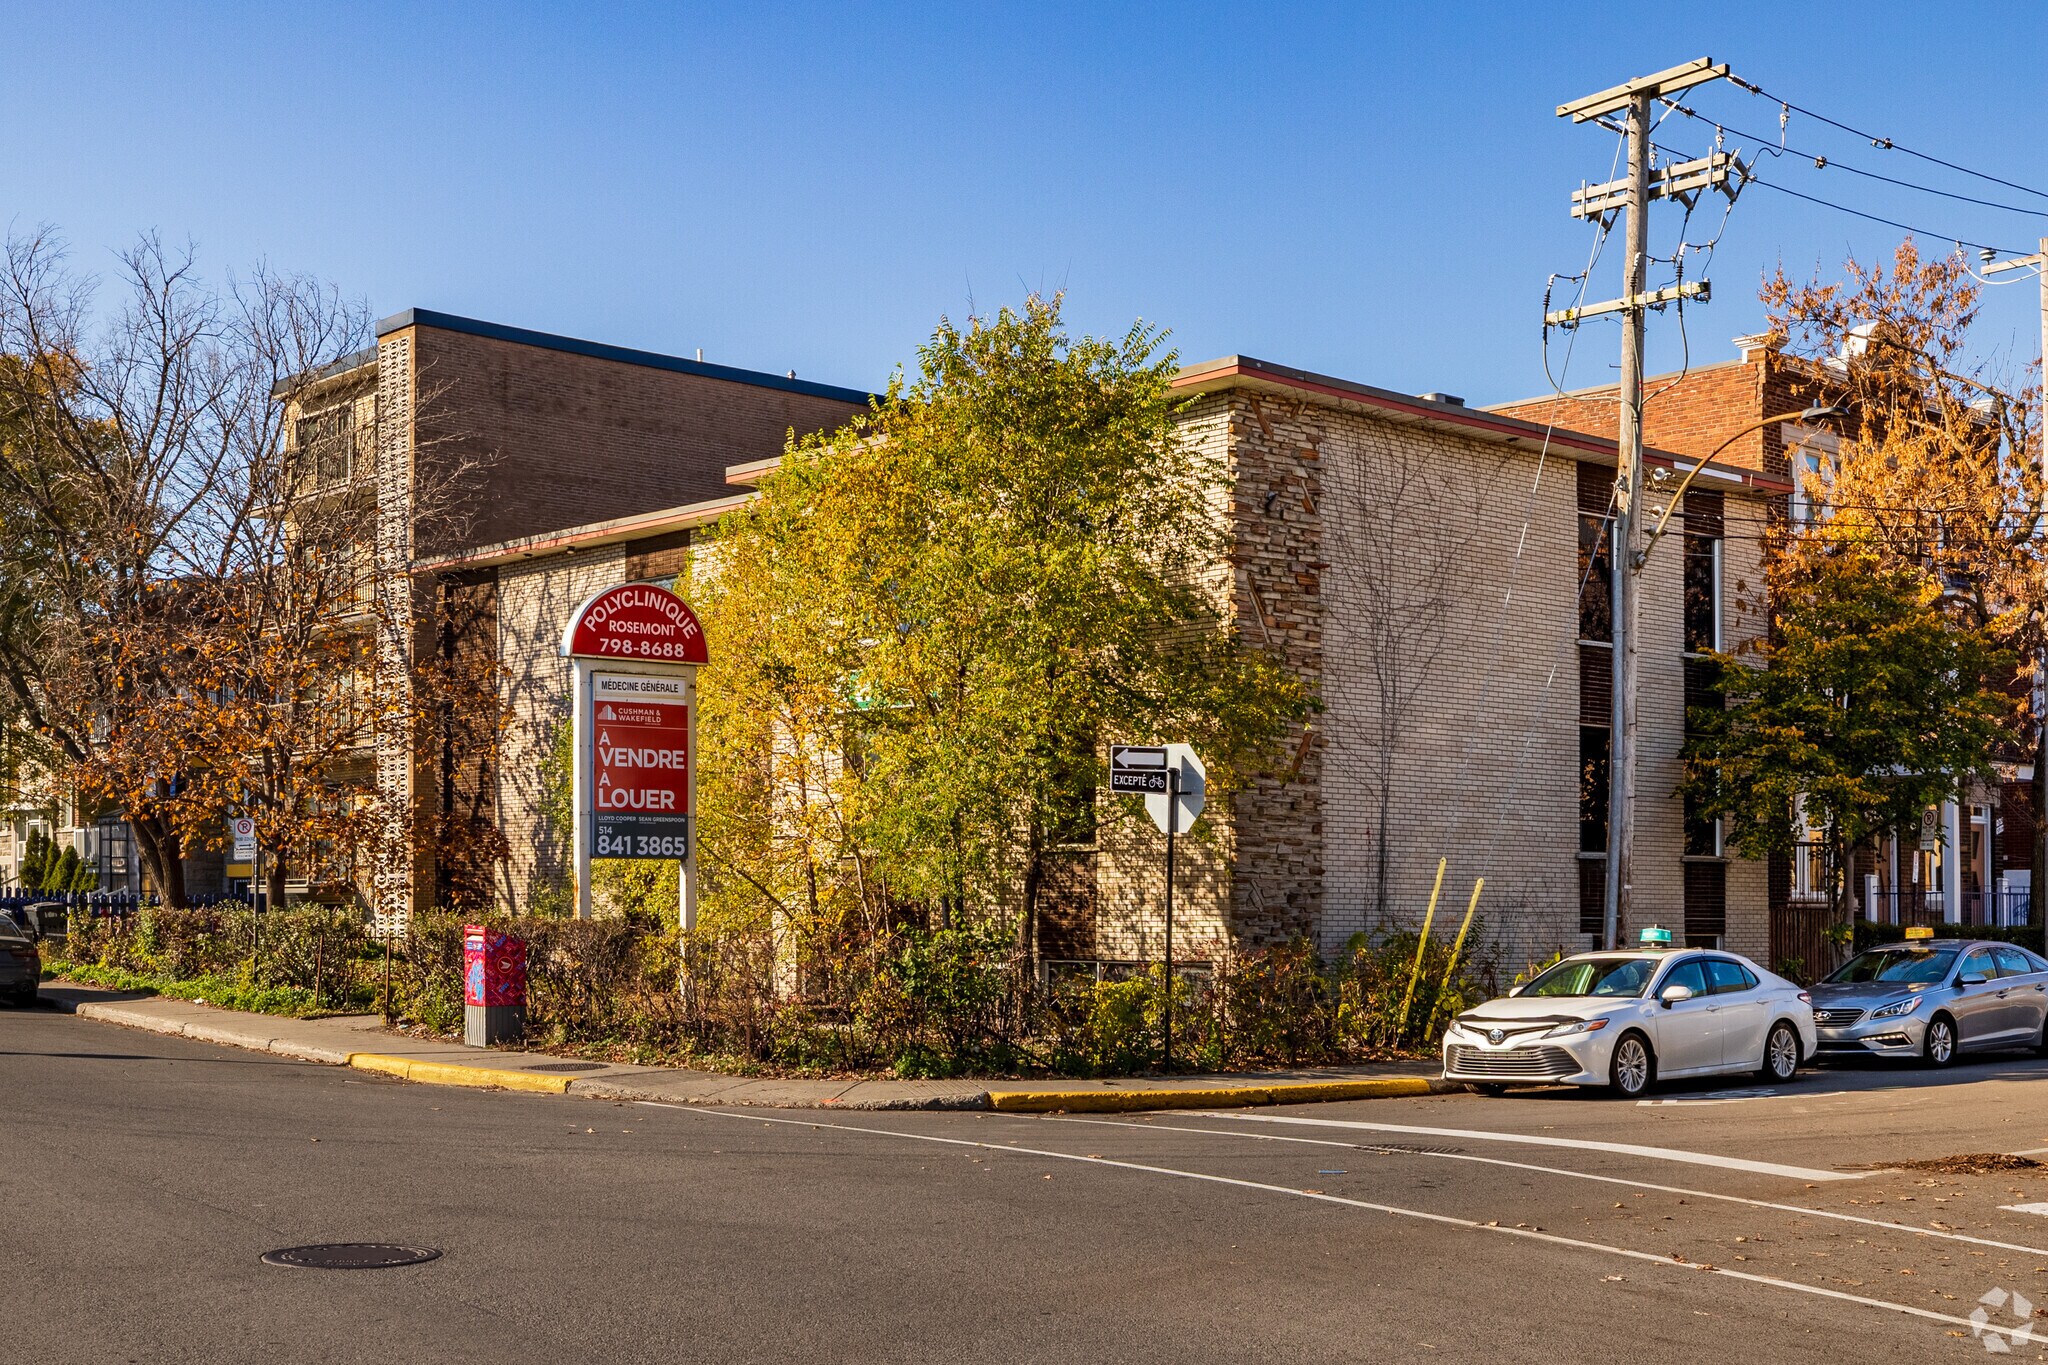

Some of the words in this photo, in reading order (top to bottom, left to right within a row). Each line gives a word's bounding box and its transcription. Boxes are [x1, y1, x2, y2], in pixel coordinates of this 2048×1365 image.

[584, 590, 698, 639] POLYCLINIQUE
[609, 620, 675, 636] ROSEMONT
[600, 638, 684, 657] 798-8688
[601, 678, 639, 691] MÉDECINE
[640, 680, 679, 693] GÉNÉRALE
[618, 708, 654, 716] CUSHMAN
[618, 715, 661, 723] WAKEFIELD
[599, 728, 611, 745] À
[598, 747, 685, 769] VENDRE
[599, 769, 611, 787] À
[1114, 774, 1147, 786] EXCEPTÉ
[598, 788, 675, 809] LOUER
[598, 826, 613, 834] 514
[597, 835, 631, 855] 841
[637, 836, 686, 856] 3865
